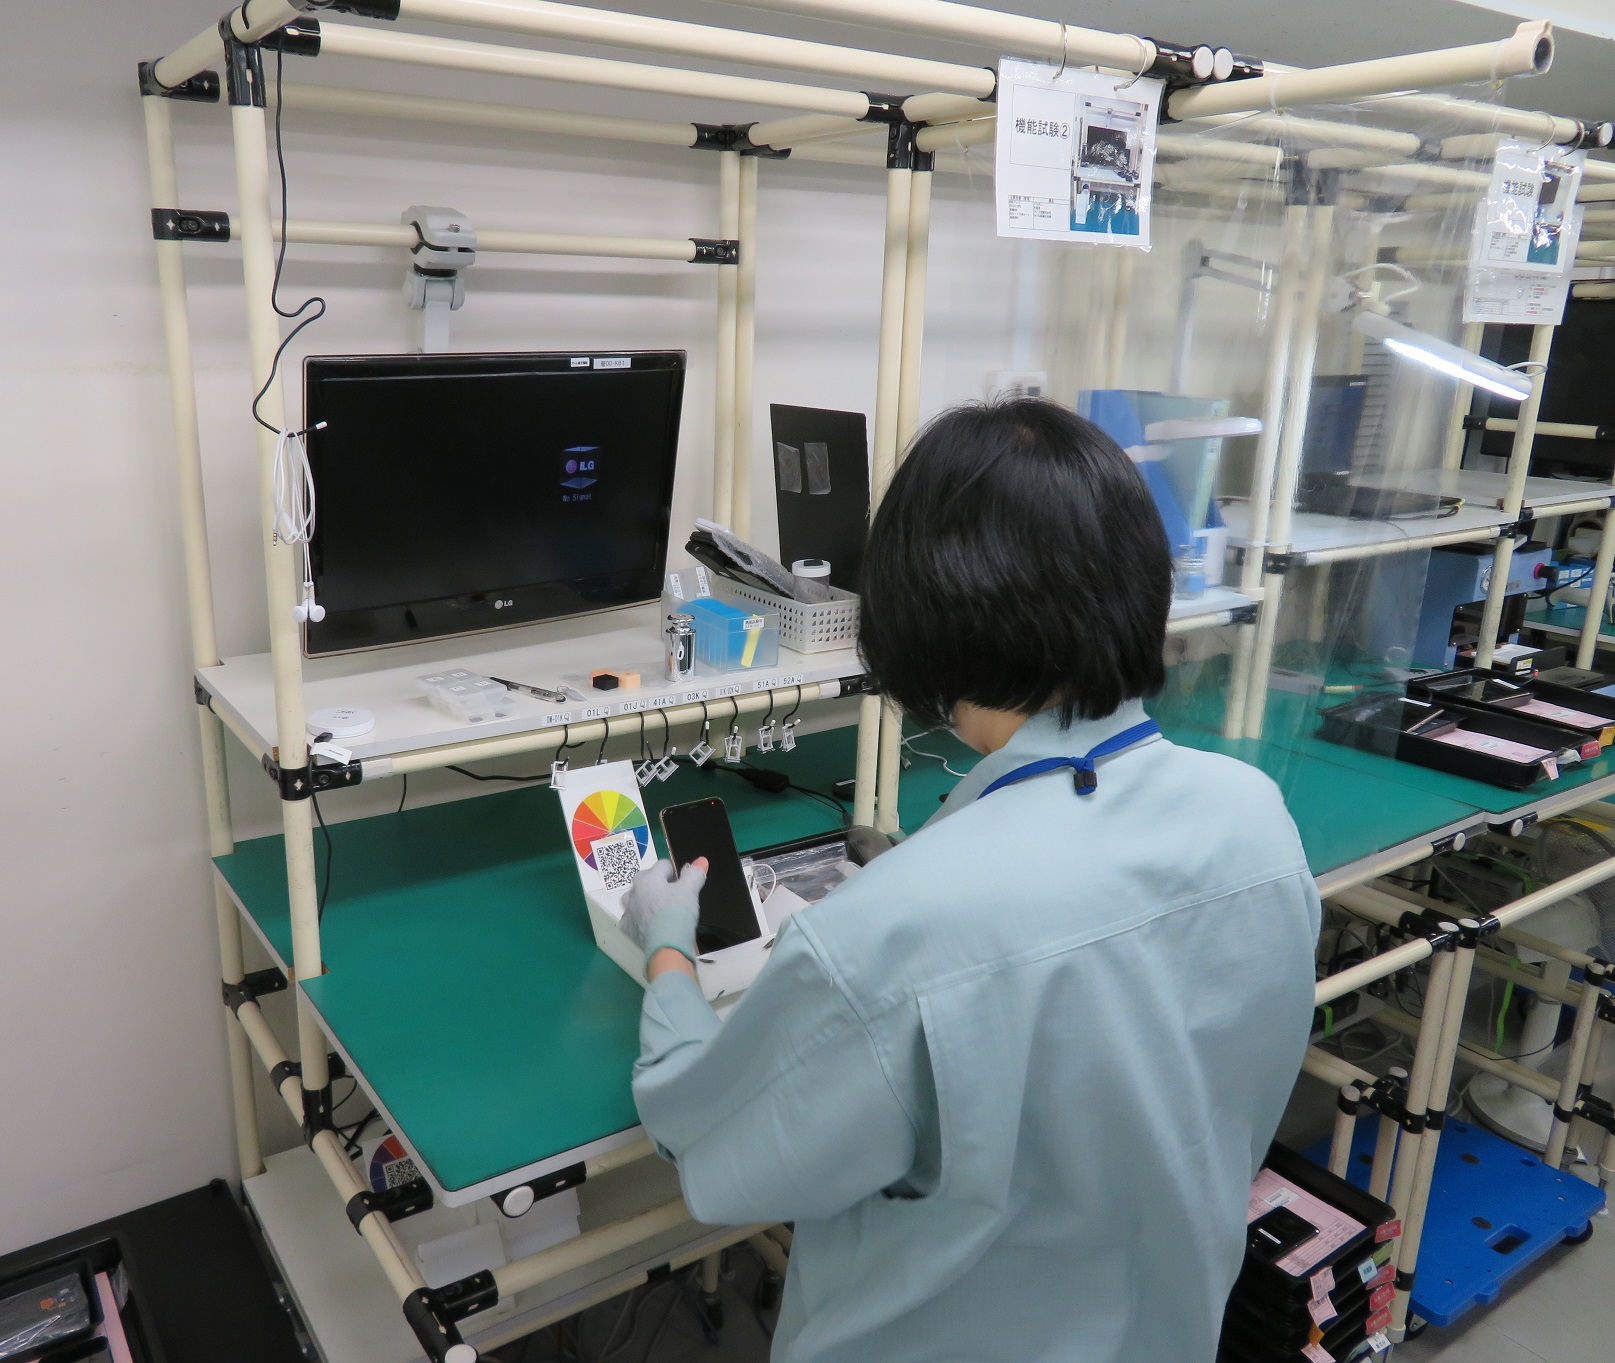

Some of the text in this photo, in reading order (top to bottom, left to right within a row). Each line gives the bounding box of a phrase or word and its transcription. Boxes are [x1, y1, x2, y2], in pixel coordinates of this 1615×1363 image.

[1015, 116, 1071, 140] 機能試験②
[579, 460, 595, 471] LG
[562, 492, 592, 502] No Signal
[503, 599, 513, 607] LG
